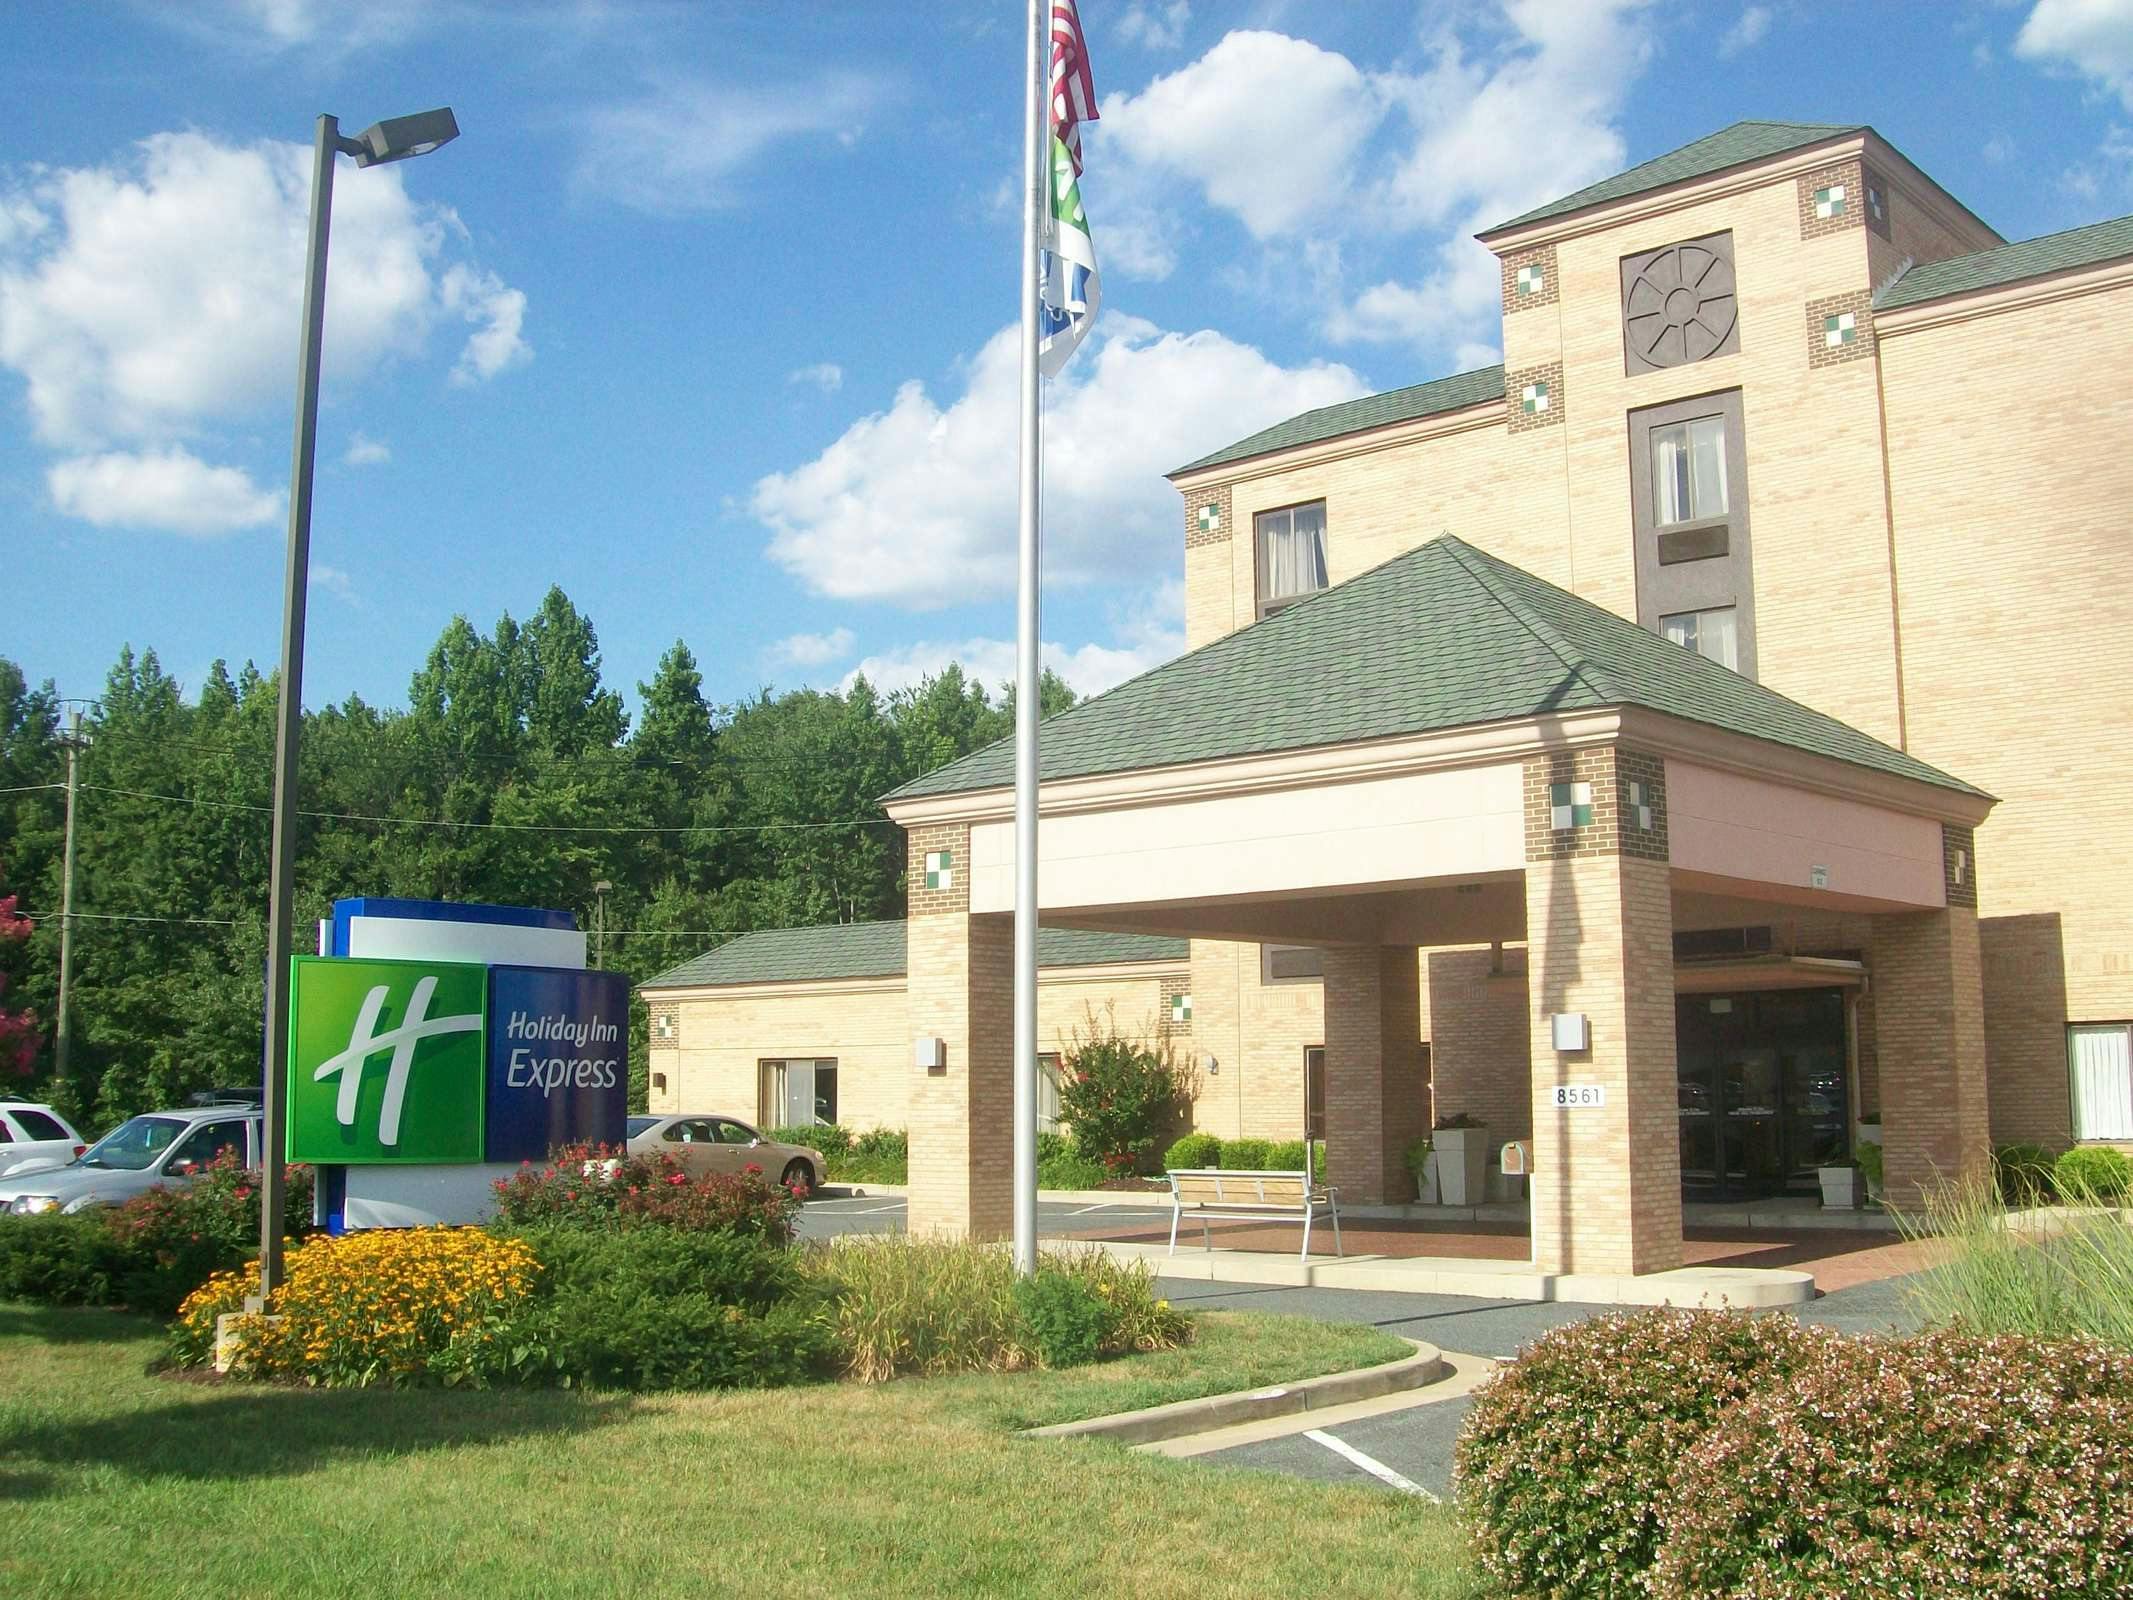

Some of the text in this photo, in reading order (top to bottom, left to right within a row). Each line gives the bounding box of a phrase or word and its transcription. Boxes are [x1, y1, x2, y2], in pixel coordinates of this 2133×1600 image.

[507, 1011, 618, 1048] Holiday Inn
[506, 1048, 618, 1098] Express
[1557, 1088, 1599, 1104] 8561
